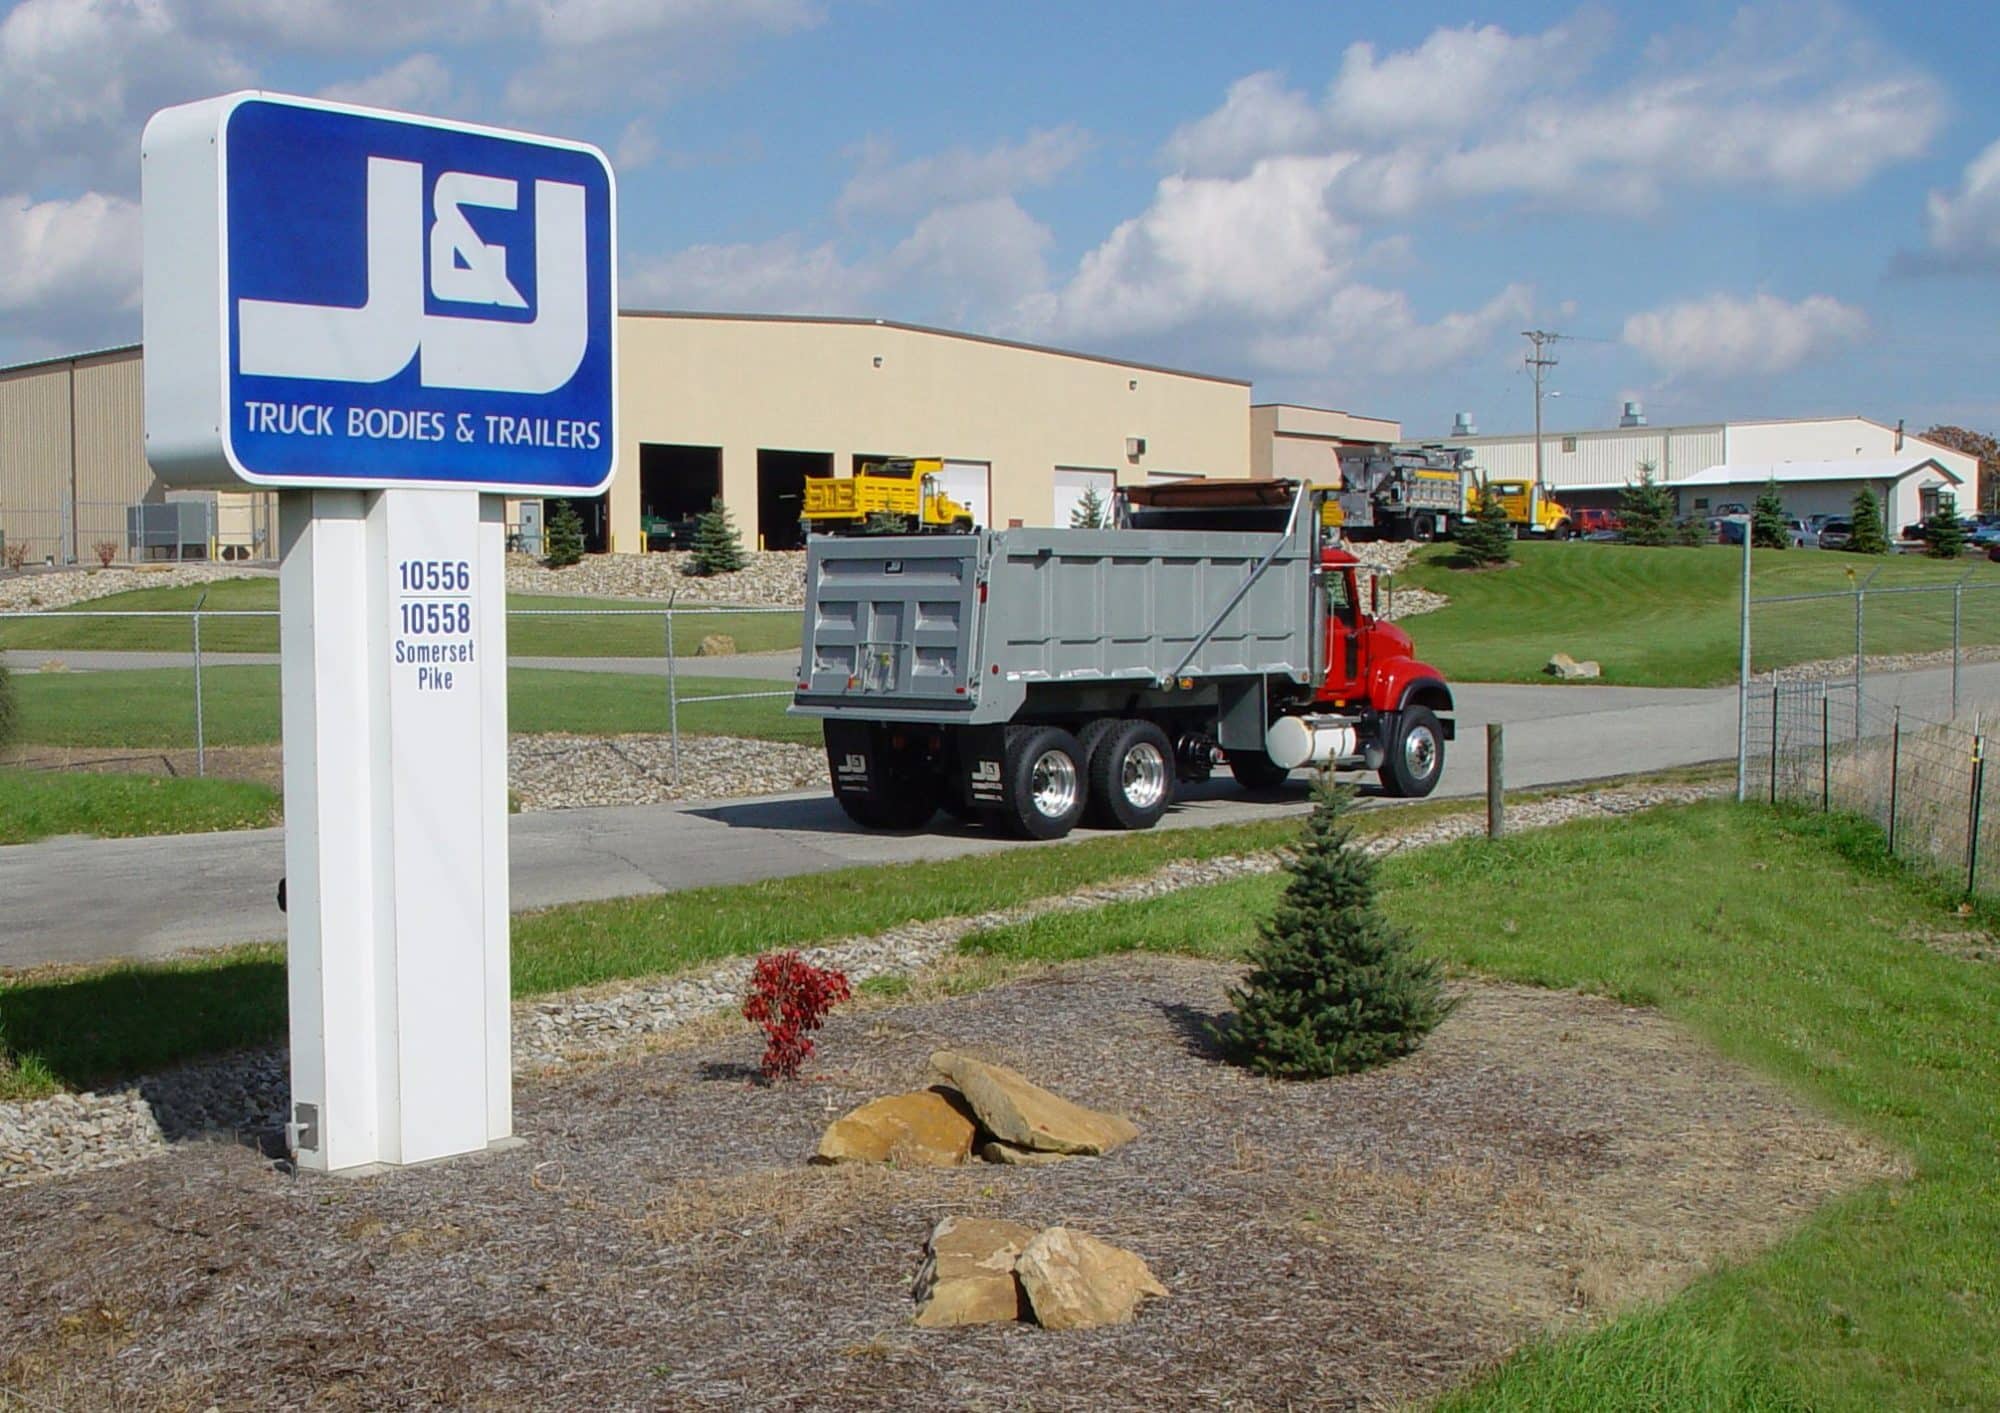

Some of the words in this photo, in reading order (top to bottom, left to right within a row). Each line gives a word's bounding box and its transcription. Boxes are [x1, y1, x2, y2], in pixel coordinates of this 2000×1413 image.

[238, 156, 588, 394] J&J
[245, 401, 334, 436] TRUCK
[347, 407, 445, 441] BODIES
[456, 413, 475, 443] &
[485, 415, 600, 449] TRAILERS
[399, 560, 470, 591] 10556
[400, 602, 471, 635] 10558
[395, 639, 475, 663] Somerset
[418, 667, 453, 690] Pike
